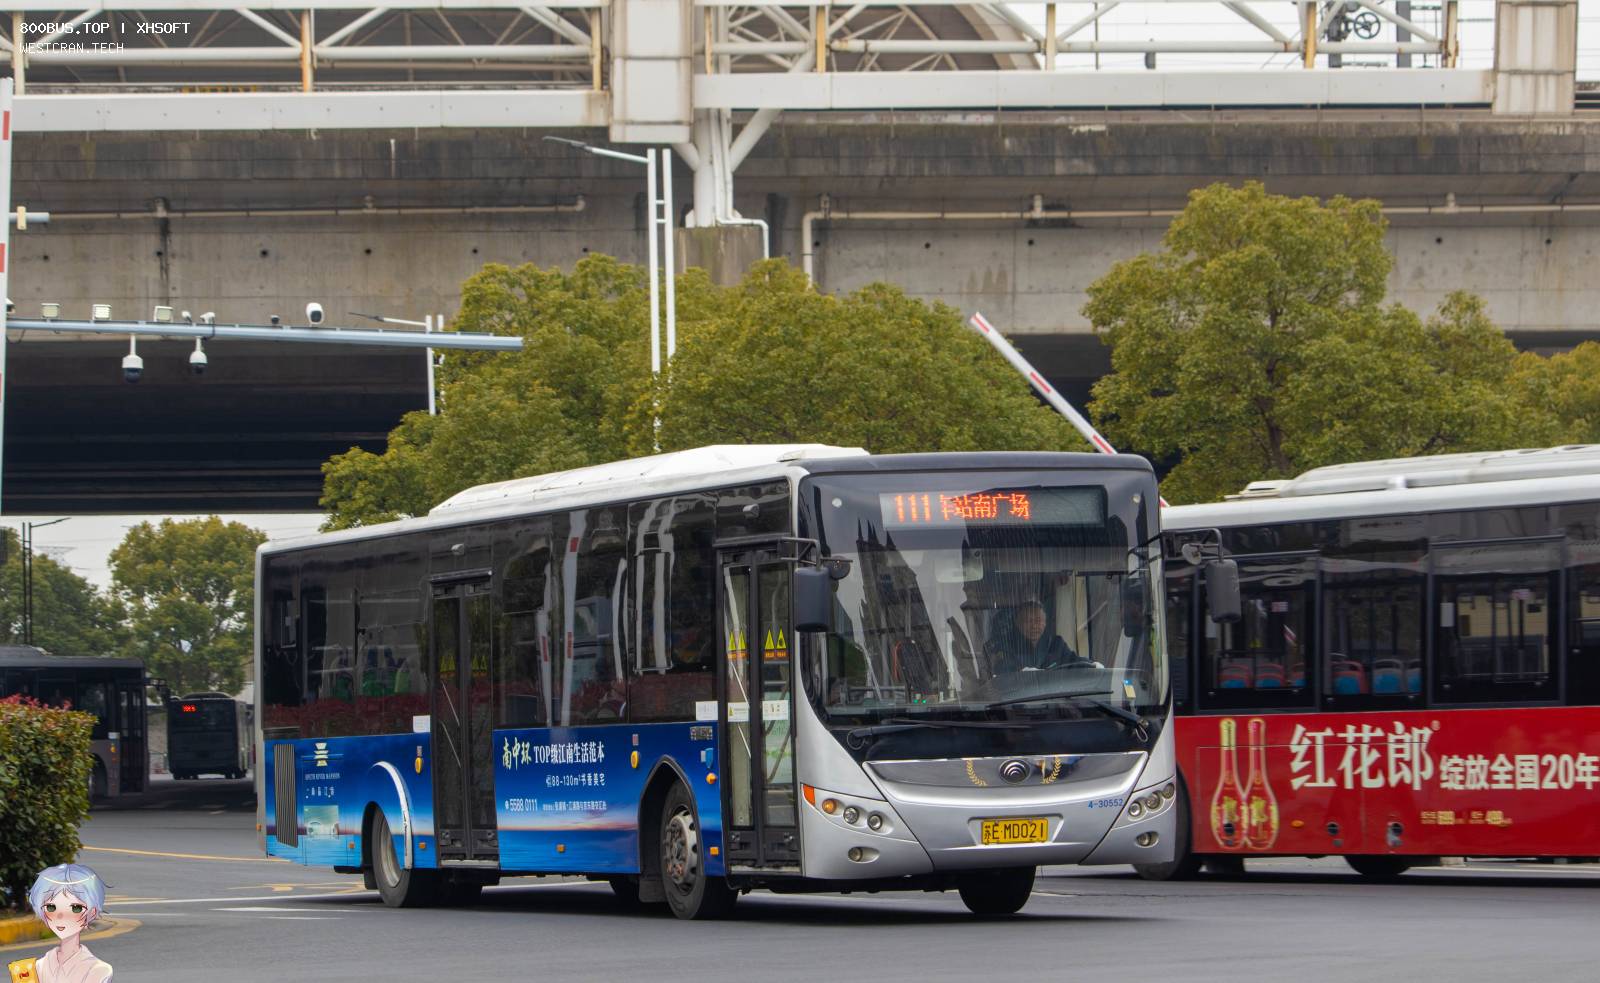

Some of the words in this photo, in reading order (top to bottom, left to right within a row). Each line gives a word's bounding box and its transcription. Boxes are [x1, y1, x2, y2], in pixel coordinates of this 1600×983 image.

[894, 494, 932, 523] 111
[1440, 753, 1600, 790] 绽放全国20年
[1088, 798, 1124, 809] 4-30552
